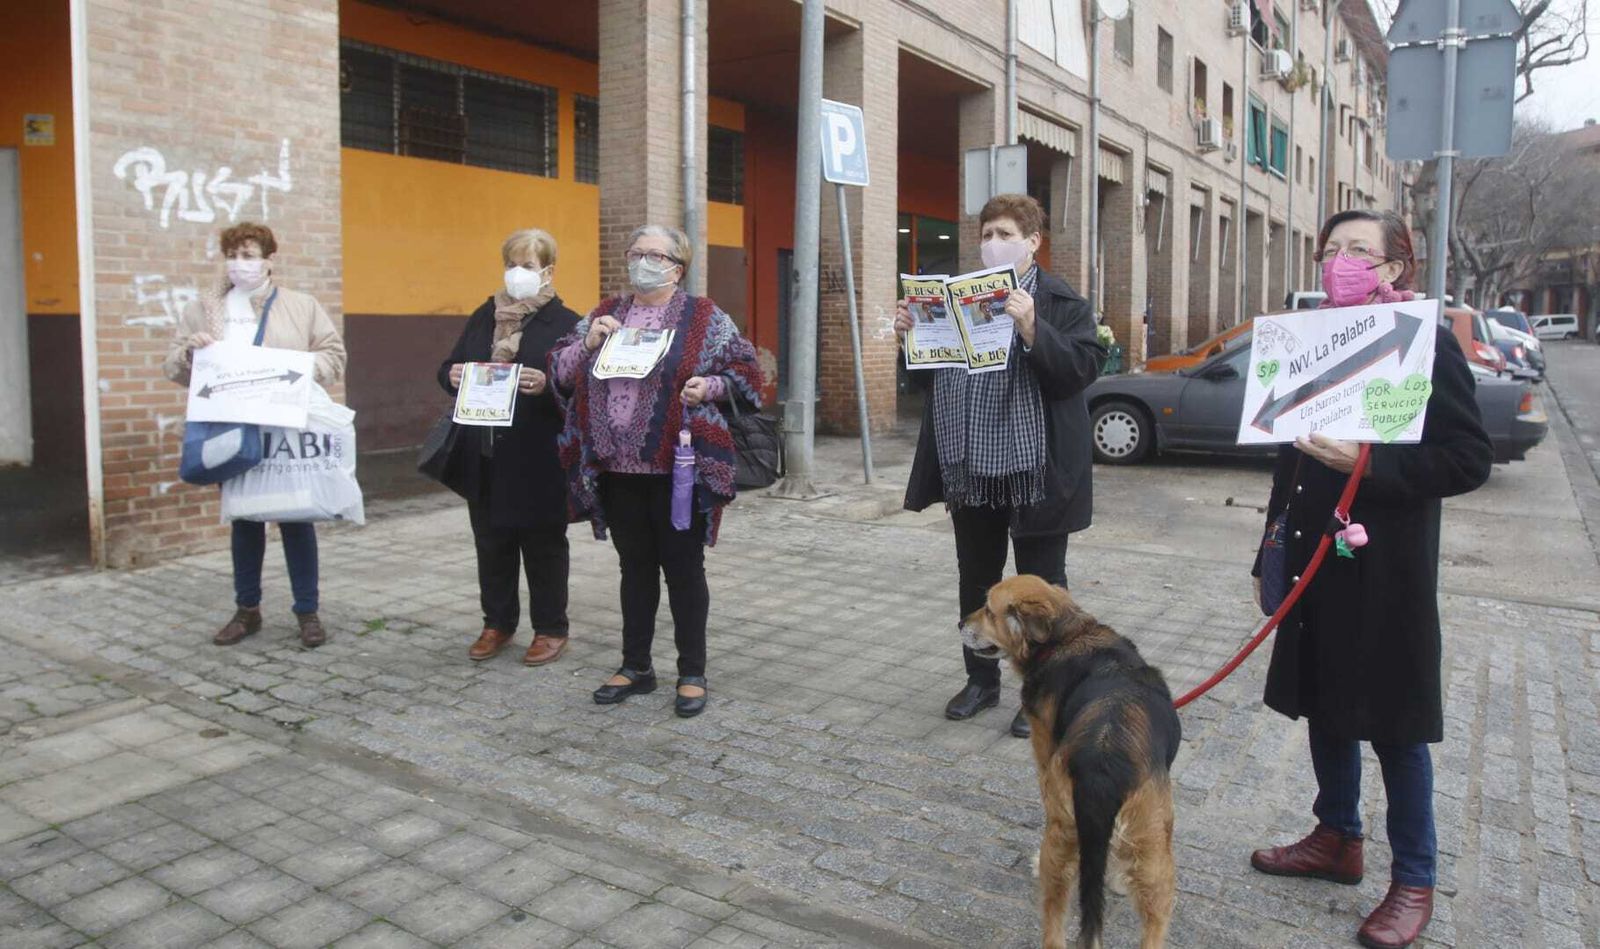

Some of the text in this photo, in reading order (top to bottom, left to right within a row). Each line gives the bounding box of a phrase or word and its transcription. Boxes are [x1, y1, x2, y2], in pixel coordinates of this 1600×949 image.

[828, 111, 857, 173] P
[953, 288, 967, 298] SE
[970, 278, 1009, 296] BUSCA
[911, 347, 963, 360] SE BUSCA
[1288, 314, 1377, 379] AVV. La Palabra
[971, 353, 985, 364] SE
[1365, 380, 1428, 400] POR LOS
[1300, 406, 1313, 420] Un
[1315, 391, 1342, 413] barrio
[1367, 395, 1425, 411] SERVICIOS
[1319, 404, 1353, 431] palabra
